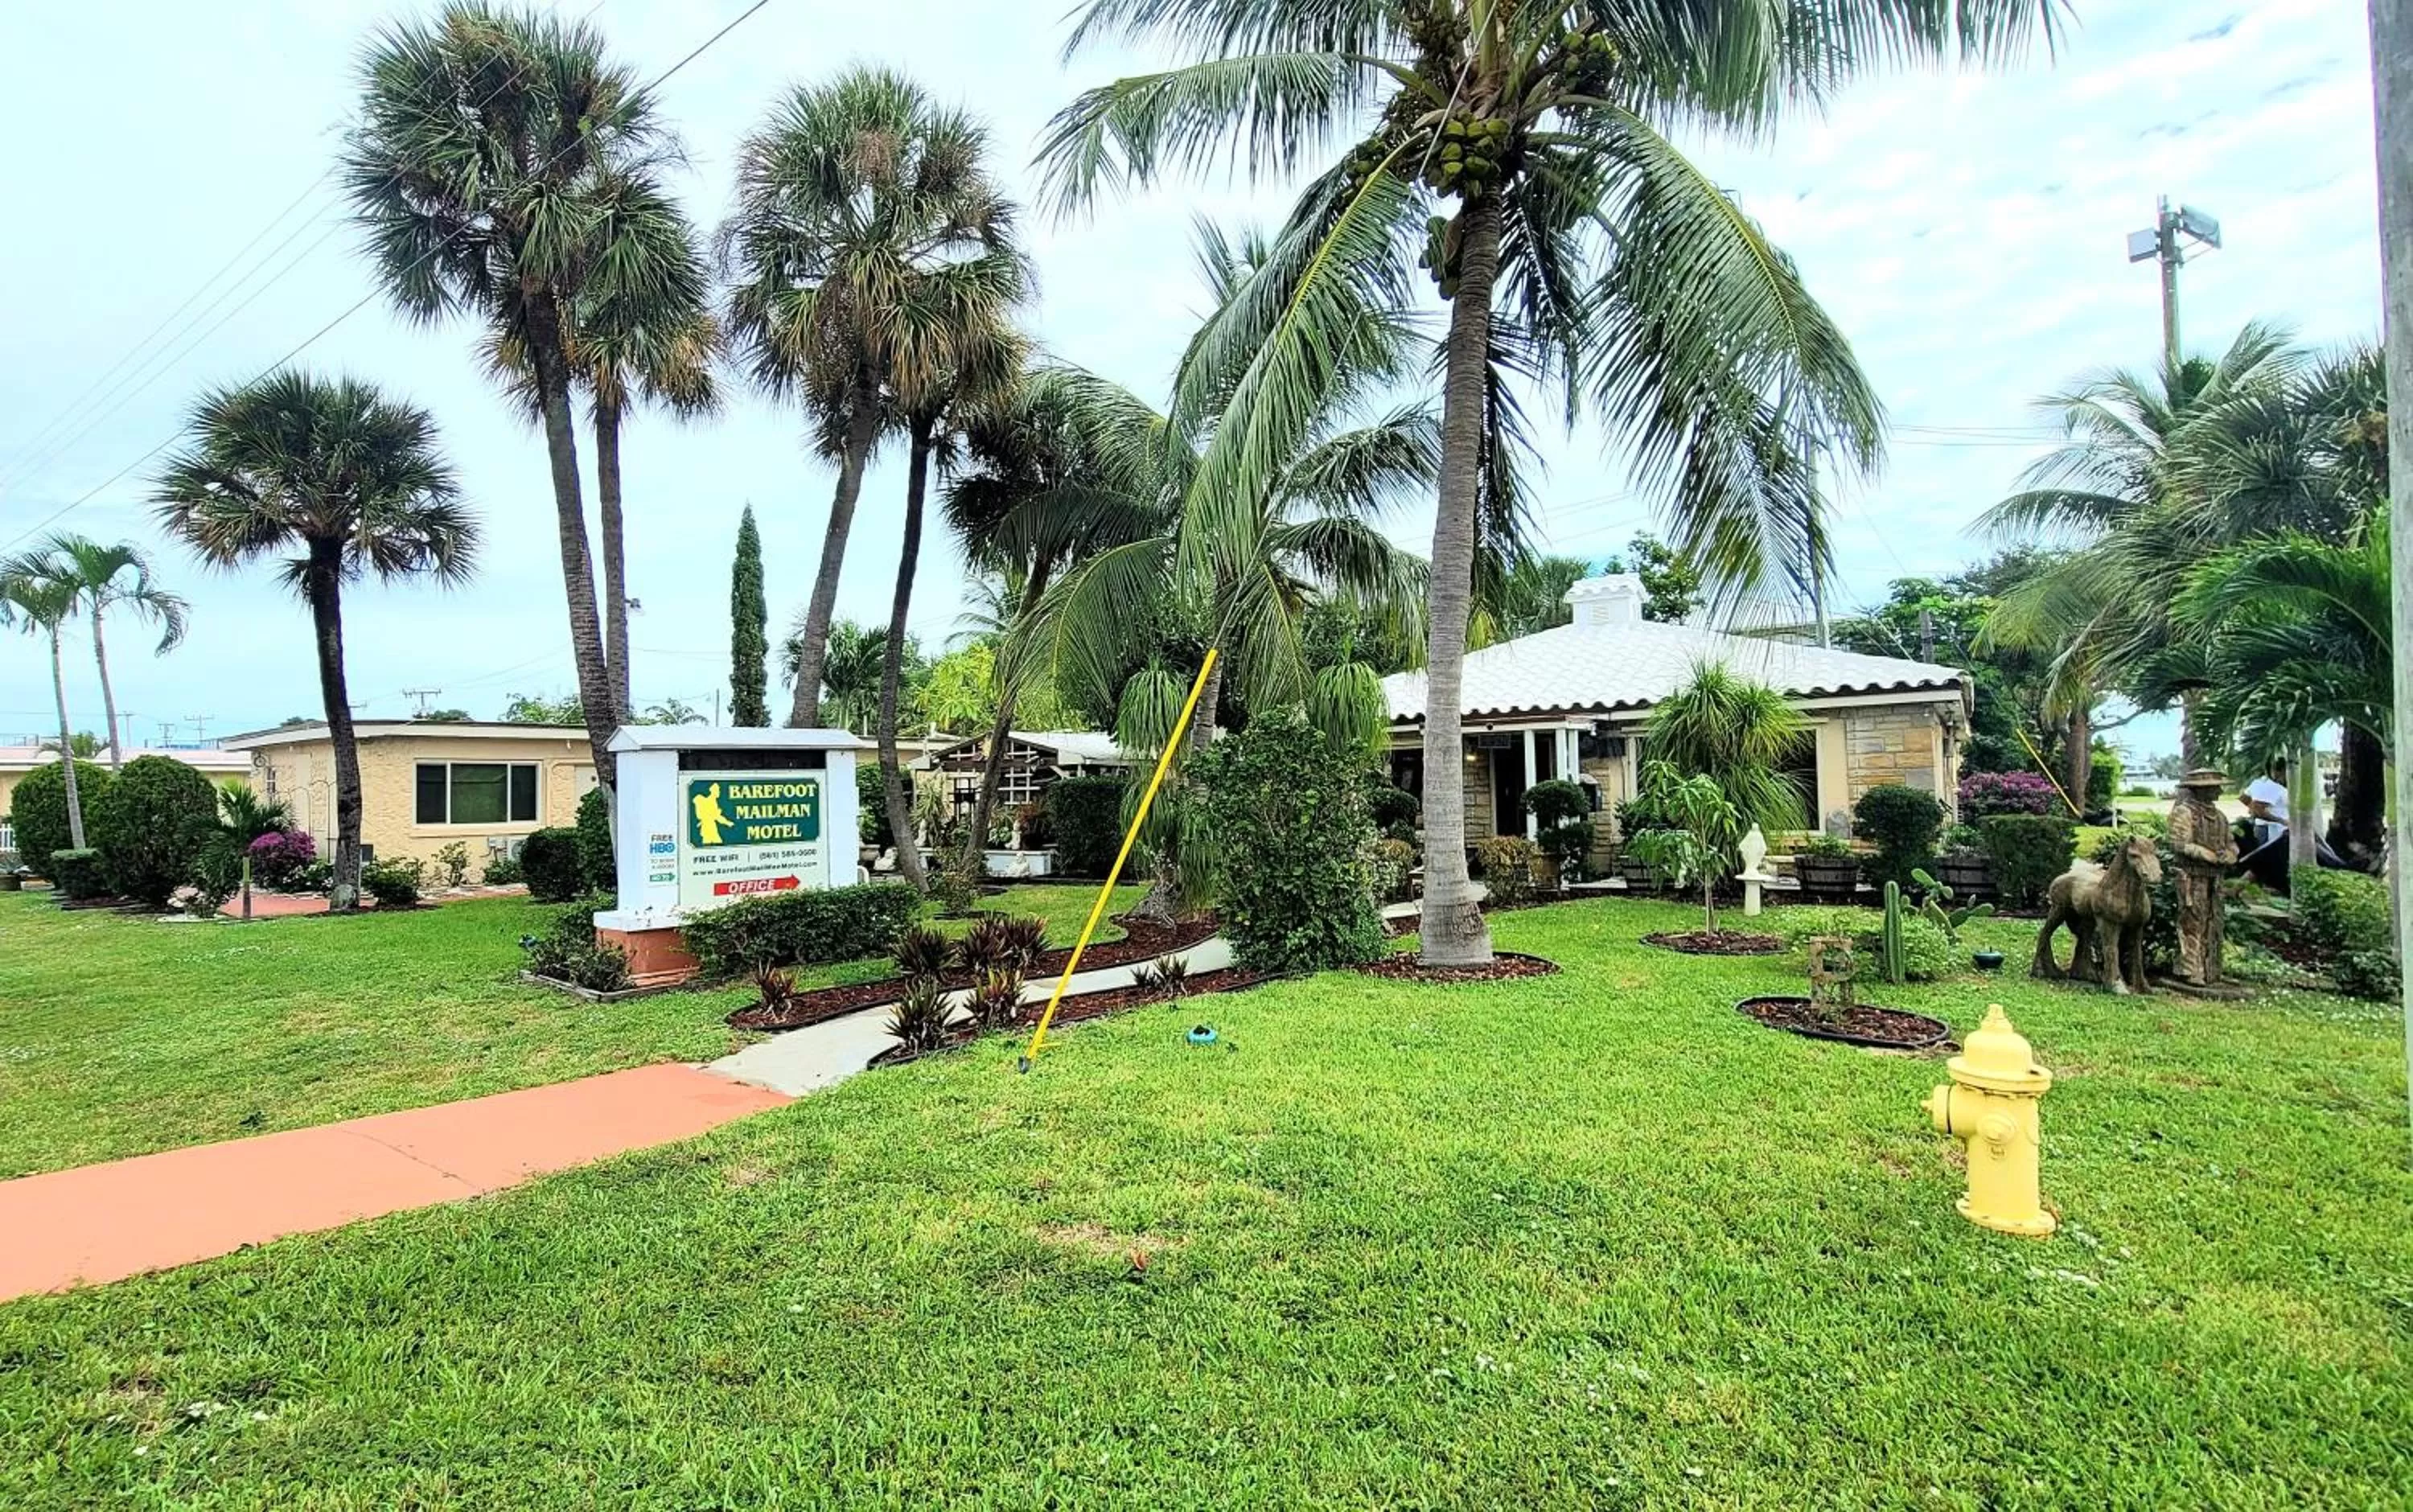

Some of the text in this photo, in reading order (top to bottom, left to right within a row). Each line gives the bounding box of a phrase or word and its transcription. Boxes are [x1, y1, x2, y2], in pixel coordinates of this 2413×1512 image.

[729, 784, 816, 799] BAREFOOT
[736, 803, 811, 820] MAILMAN
[651, 834, 673, 842] FREE
[746, 824, 802, 840] MOTEL
[649, 842, 676, 854] HBO
[693, 855, 717, 865] FREE
[728, 880, 775, 894] OFFICE
